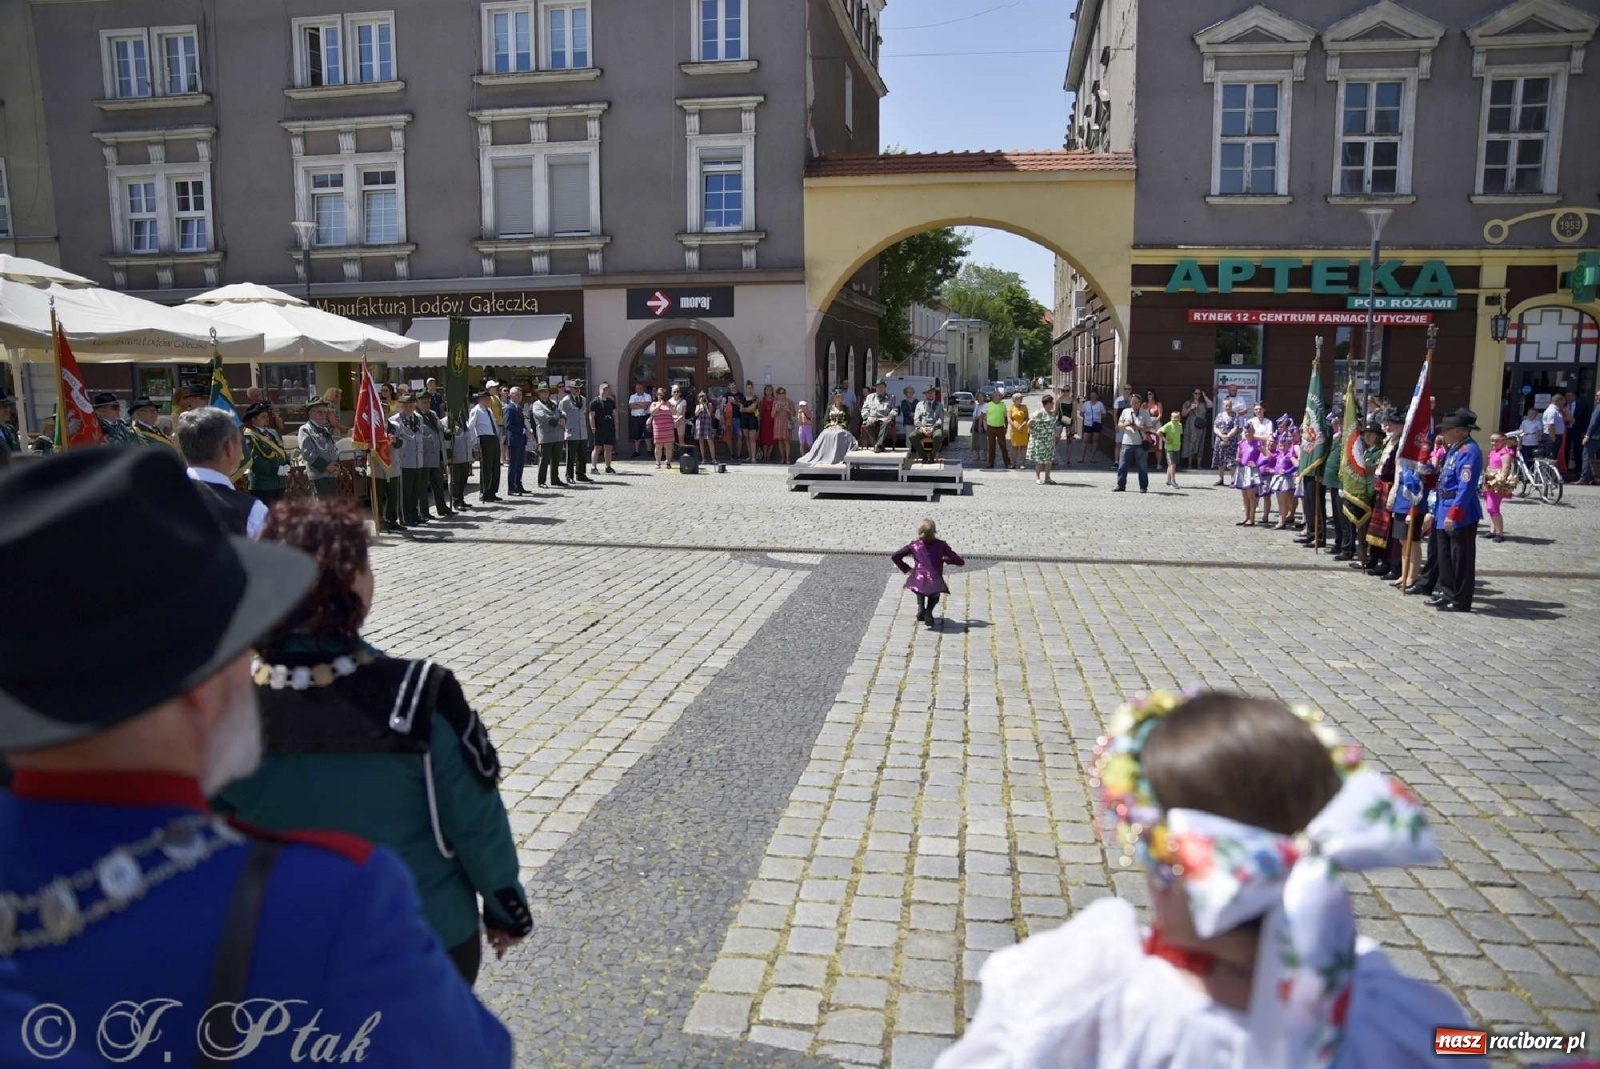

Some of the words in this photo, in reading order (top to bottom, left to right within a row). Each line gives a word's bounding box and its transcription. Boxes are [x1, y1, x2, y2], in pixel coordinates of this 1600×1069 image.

[1560, 220, 1581, 230] 1953
[1164, 258, 1458, 296] APTEKA
[315, 297, 407, 317] Manufaktura
[412, 296, 464, 314] Lodów
[469, 291, 539, 313] Gałeczka
[680, 296, 710, 310] moraj
[1390, 297, 1452, 308] RÓŻAMI
[1193, 312, 1232, 321] RYNEK
[1236, 312, 1249, 321] 12
[1259, 313, 1315, 322] CENTRUM
